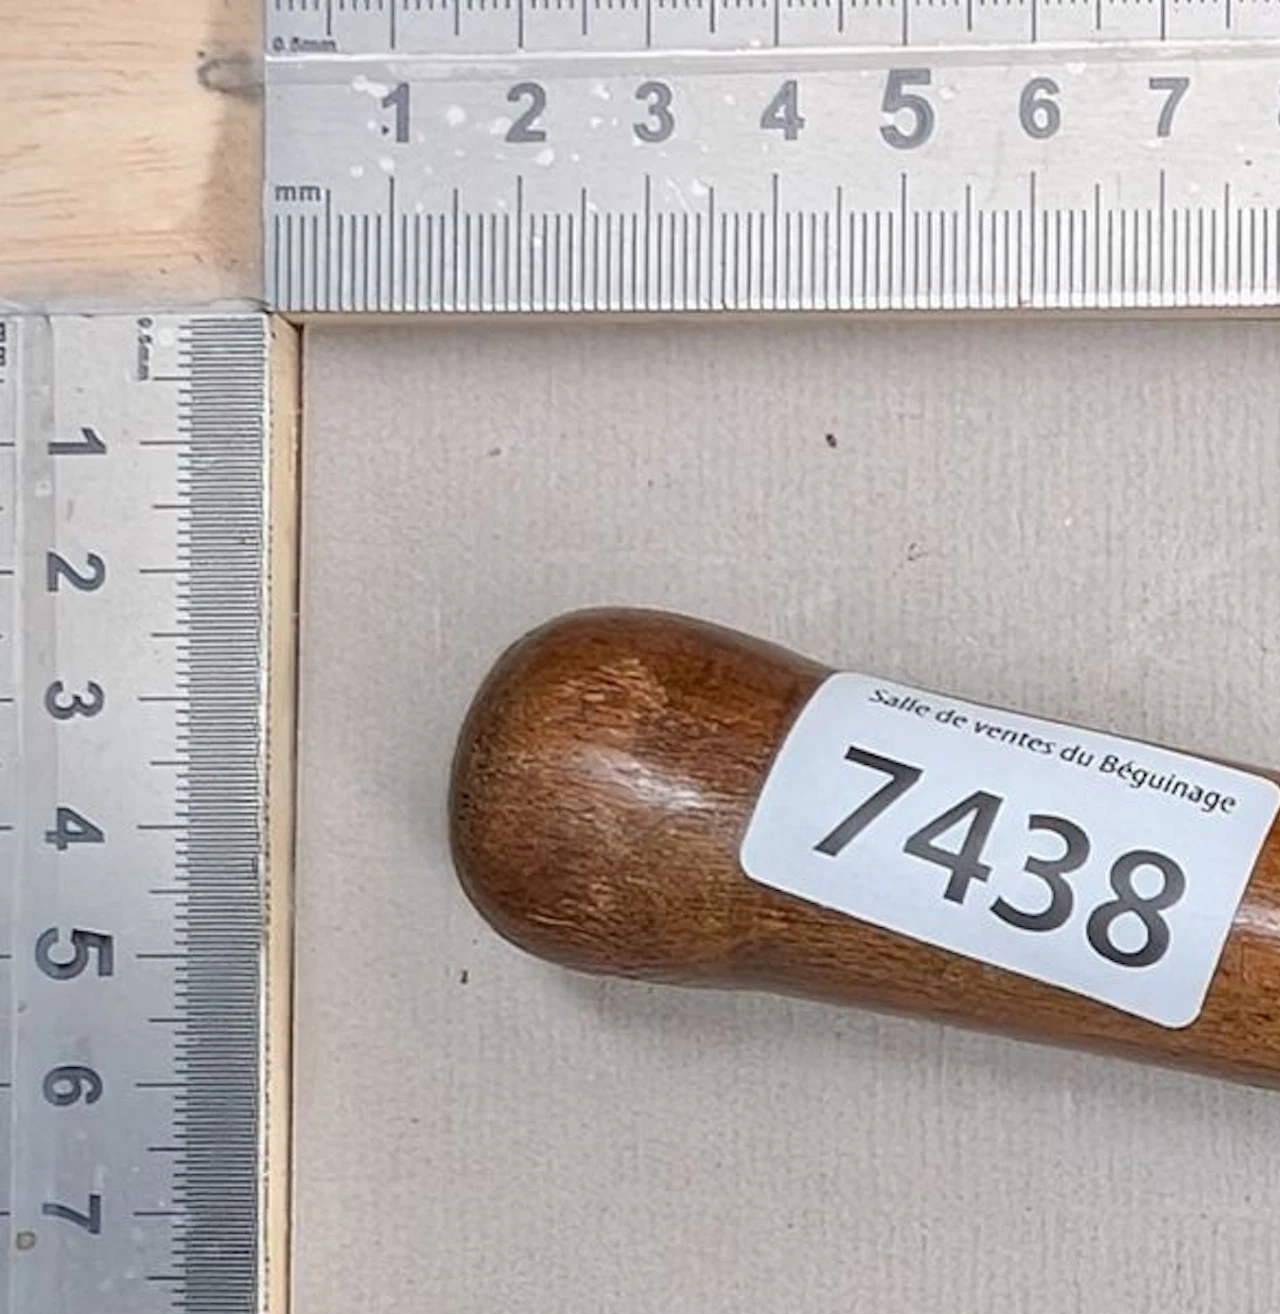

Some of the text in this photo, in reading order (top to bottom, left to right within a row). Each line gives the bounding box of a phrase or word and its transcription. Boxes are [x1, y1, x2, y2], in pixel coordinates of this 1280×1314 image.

[382, 83, 409, 142] 1
[506, 83, 545, 142] 2
[634, 82, 674, 142] 3
[760, 81, 804, 140] 4
[881, 70, 933, 147] 5
[1020, 79, 1059, 138] 6
[1149, 78, 1189, 137] 7
[275, 185, 321, 201] mm
[48, 428, 105, 455] 1
[48, 552, 104, 591] 2
[46, 681, 103, 719] 3
[868, 686, 1238, 815] Salle de ventes du Béguinage
[46, 808, 104, 850] 4
[811, 744, 1187, 968] 7438
[35, 928, 114, 980] 5
[42, 1065, 103, 1106] 6
[44, 1194, 100, 1234] 7
